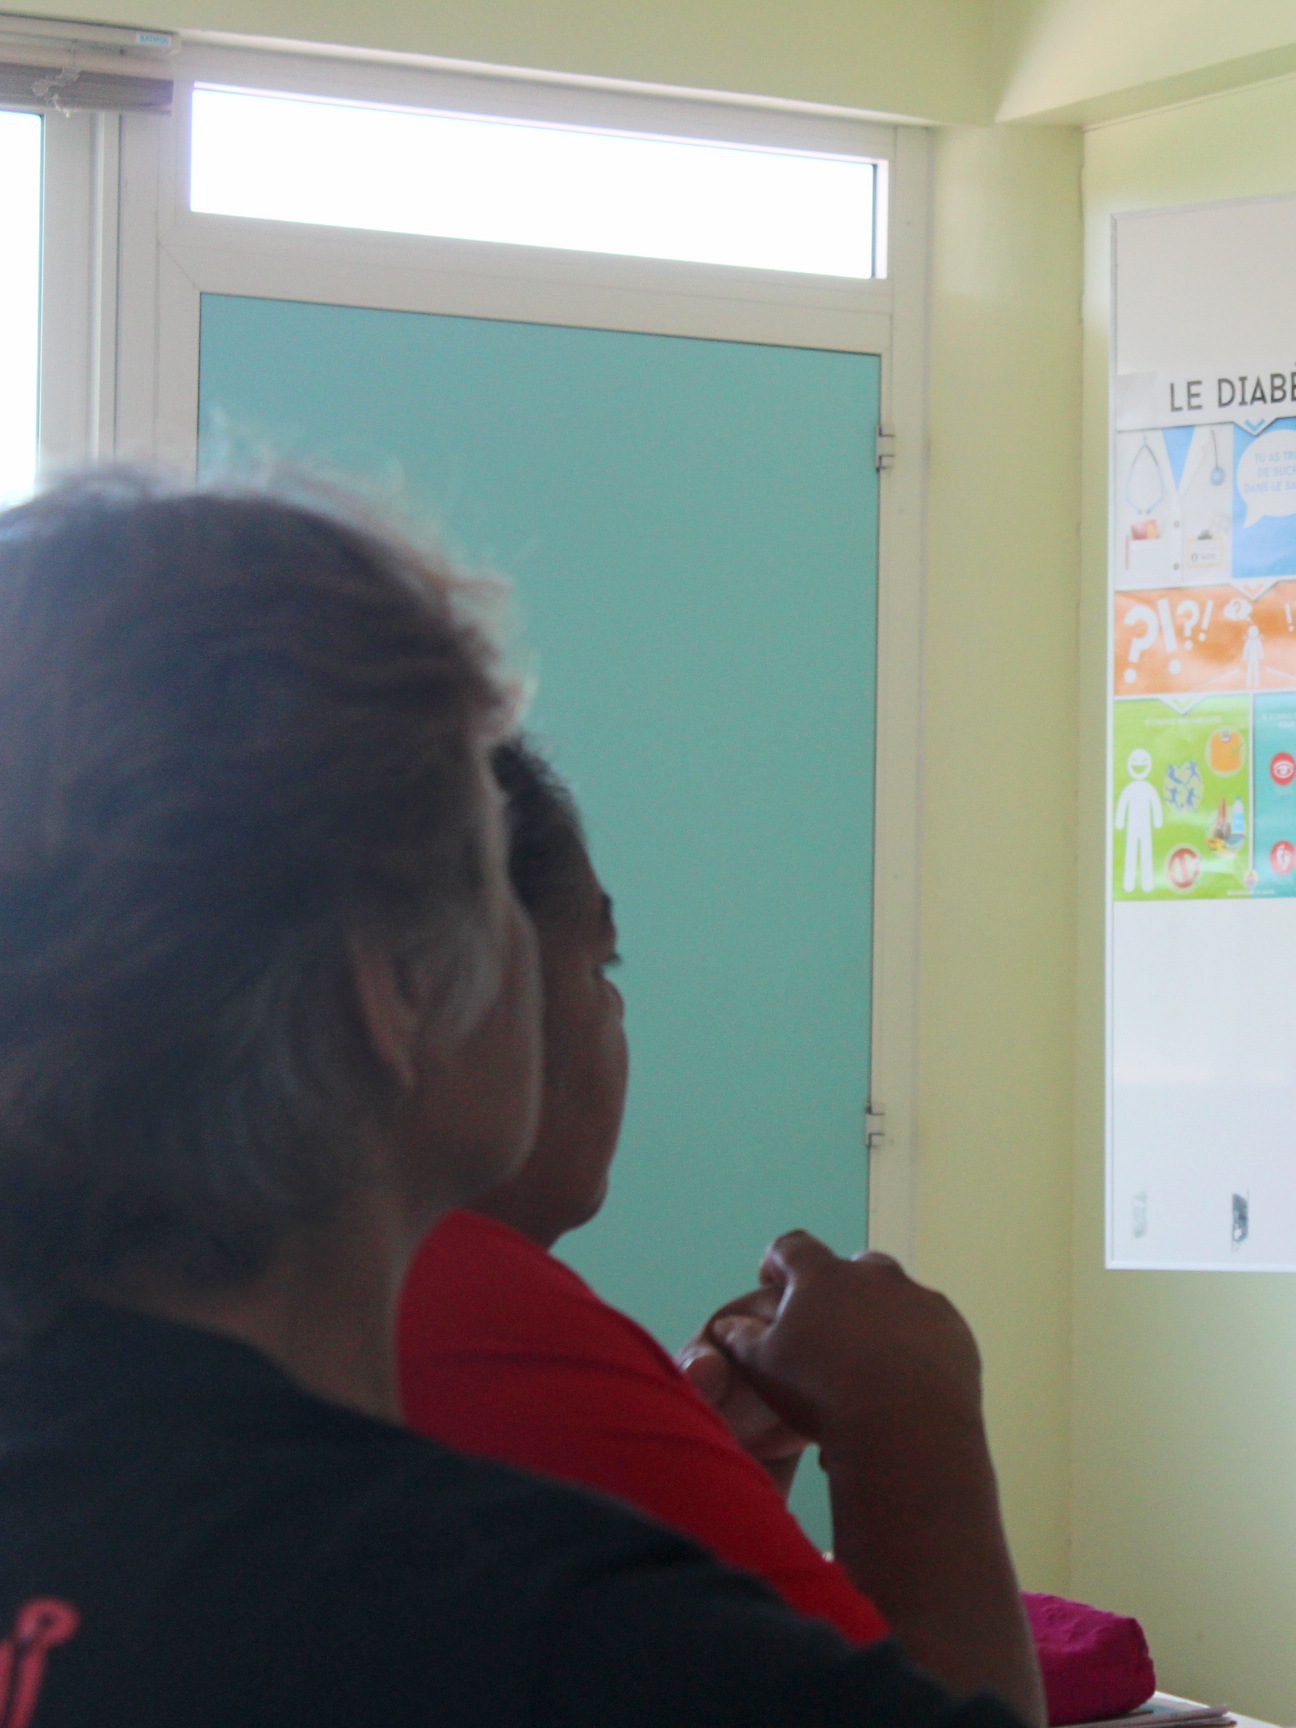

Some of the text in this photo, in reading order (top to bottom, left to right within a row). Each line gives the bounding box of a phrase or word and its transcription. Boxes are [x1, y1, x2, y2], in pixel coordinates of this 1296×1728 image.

[1169, 380, 1203, 412] LE
[1254, 452, 1266, 463] TU
[1268, 451, 1281, 462] AS
[1257, 467, 1269, 478] DE
[1244, 481, 1269, 493] DANS
[1271, 480, 1282, 492] LE
